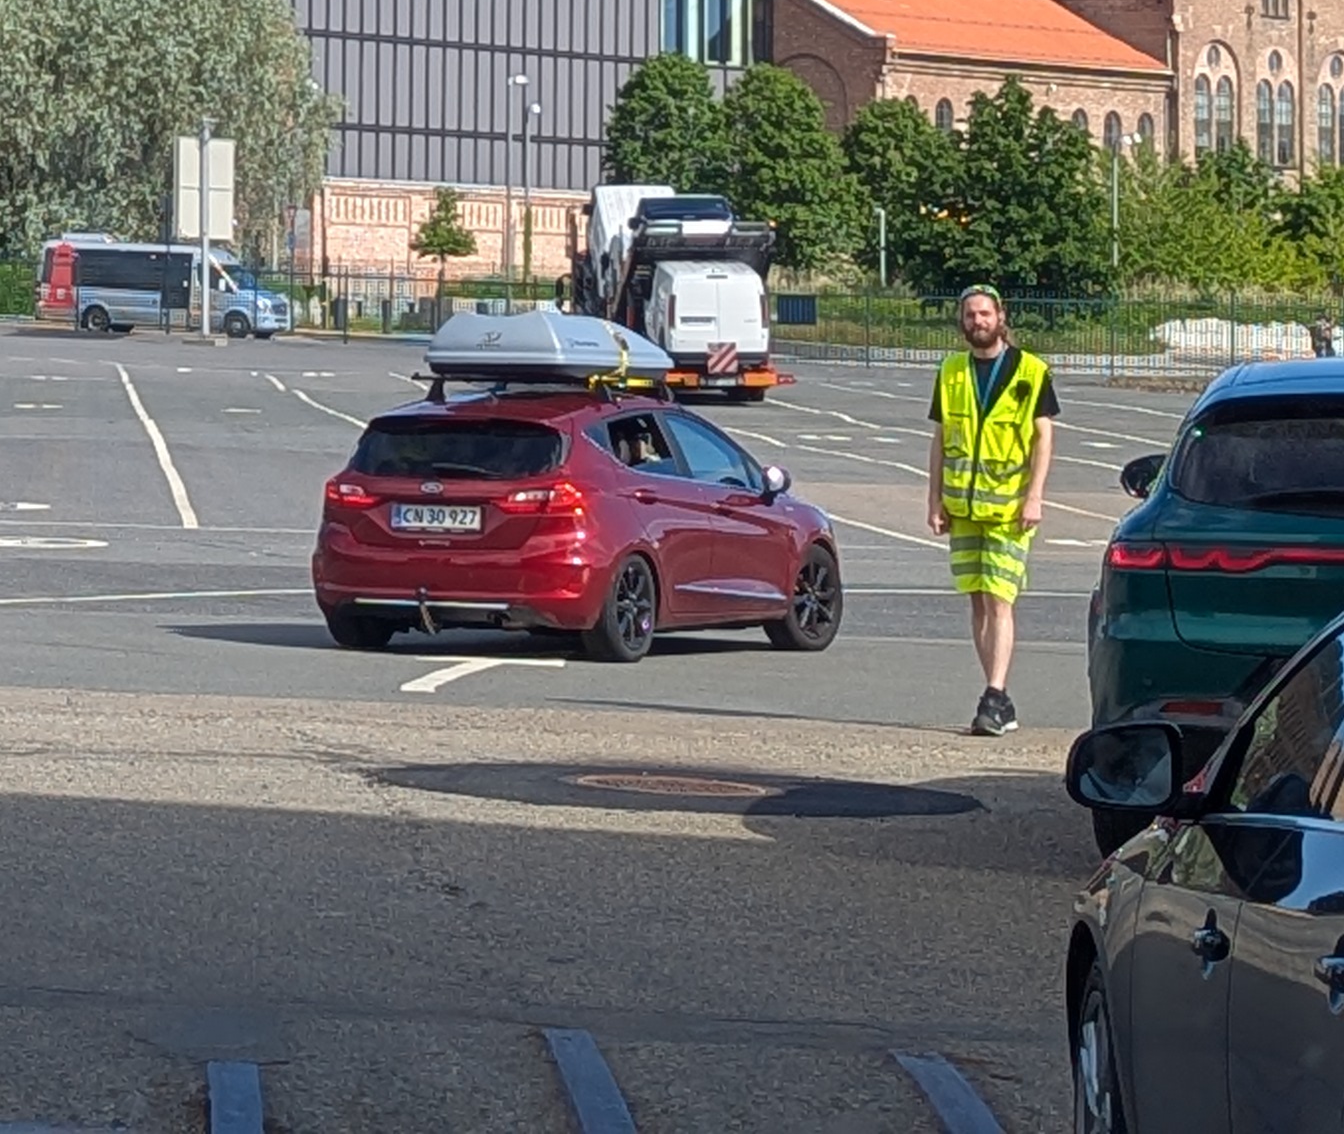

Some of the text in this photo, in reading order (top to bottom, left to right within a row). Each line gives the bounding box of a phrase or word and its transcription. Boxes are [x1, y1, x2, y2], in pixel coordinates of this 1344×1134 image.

[403, 507, 477, 526] CN 30 927
